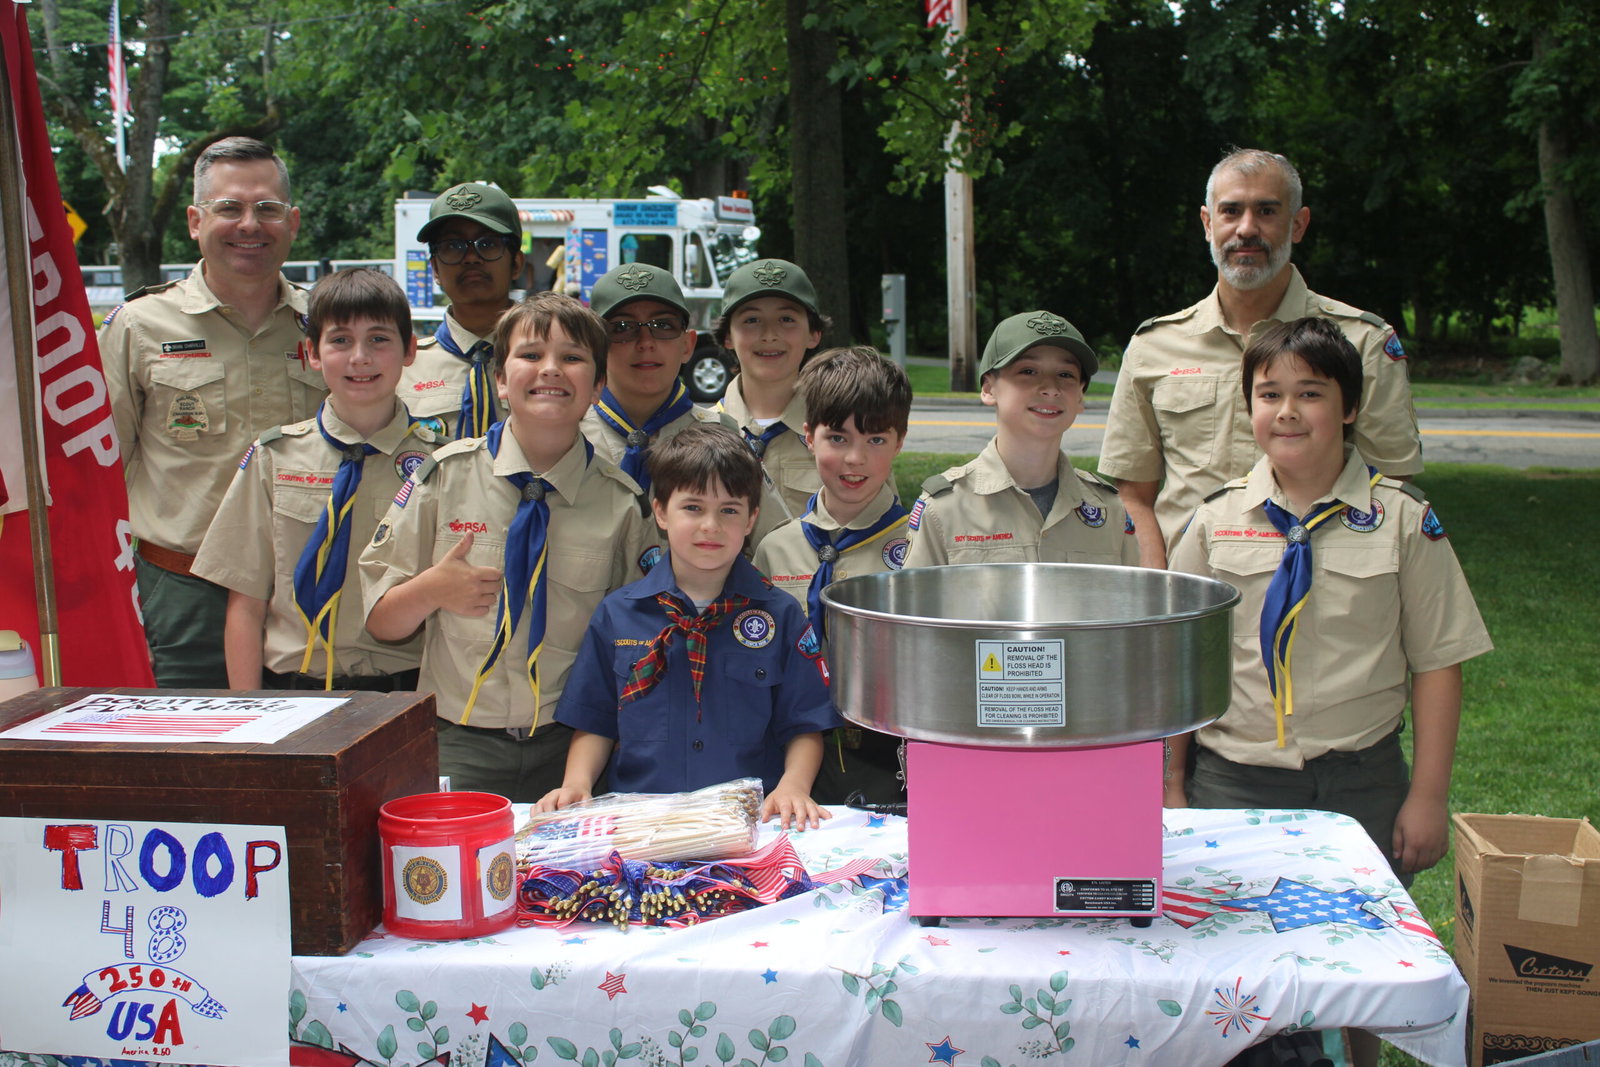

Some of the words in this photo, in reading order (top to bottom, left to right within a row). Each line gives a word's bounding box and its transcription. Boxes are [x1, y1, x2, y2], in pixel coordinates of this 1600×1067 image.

[1182, 367, 1201, 375] BSA
[426, 380, 446, 389] BSA
[278, 474, 304, 482] SCOUTING
[464, 521, 488, 533] BSA
[992, 532, 1013, 540] AMERICA
[65, 704, 183, 713] FLAGS
[43, 824, 282, 901] TROOP
[100, 900, 188, 964] 48
[106, 998, 184, 1046] USA
[121, 1046, 149, 1055] America
